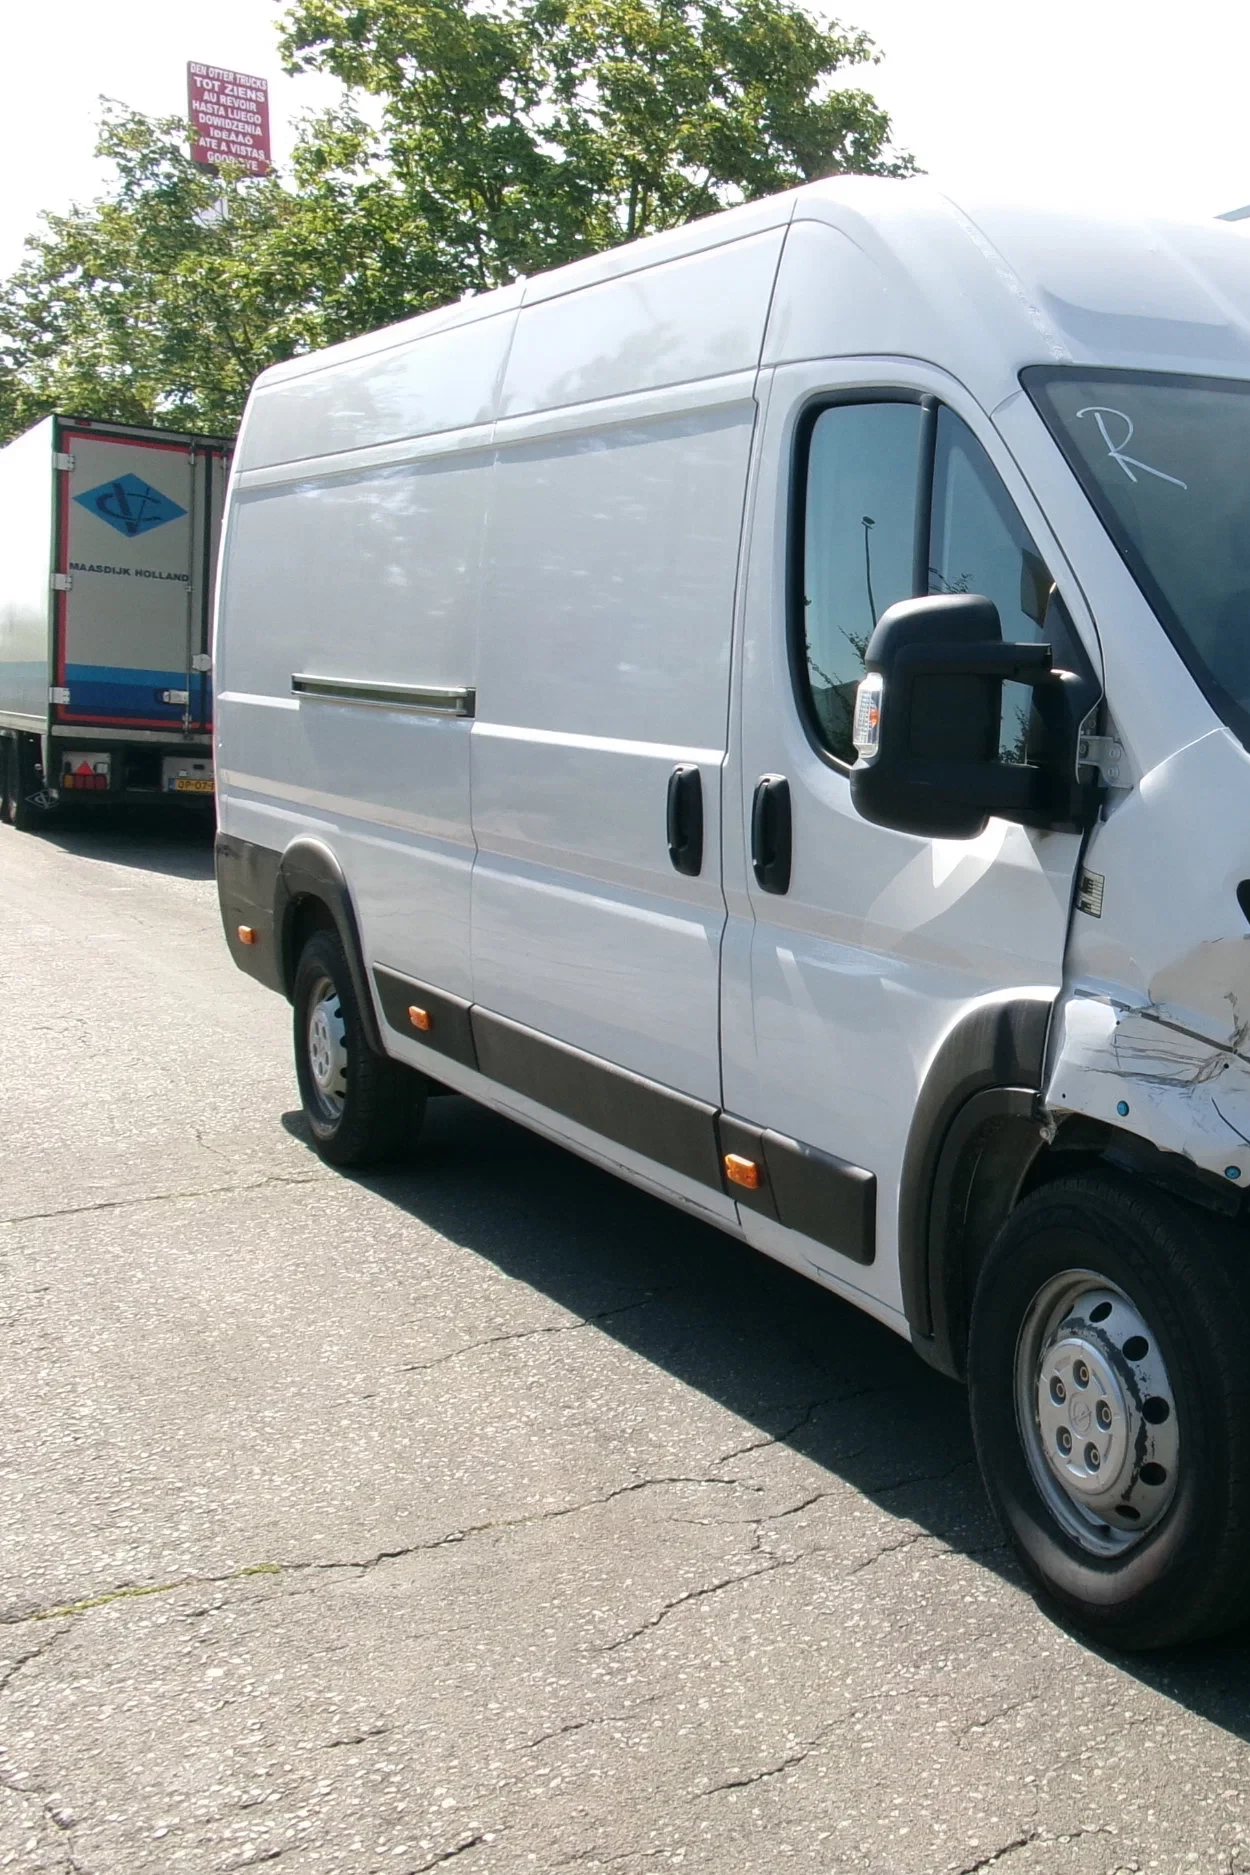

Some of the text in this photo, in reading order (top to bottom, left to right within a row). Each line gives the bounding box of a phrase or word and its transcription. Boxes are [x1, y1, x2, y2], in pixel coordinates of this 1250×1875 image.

[190, 62, 267, 90] DEN OTTER TRUCKS
[193, 76, 266, 102] TOT ZIENS
[192, 99, 262, 124] HASTA LUEGO
[203, 91, 257, 112] AU REVOIR
[198, 113, 263, 136] DOWIDZENIA
[199, 136, 265, 160] ATE A VISTAS
[1076, 406, 1188, 490] R
[69, 562, 190, 582] MAASDIJK HOLLAND
